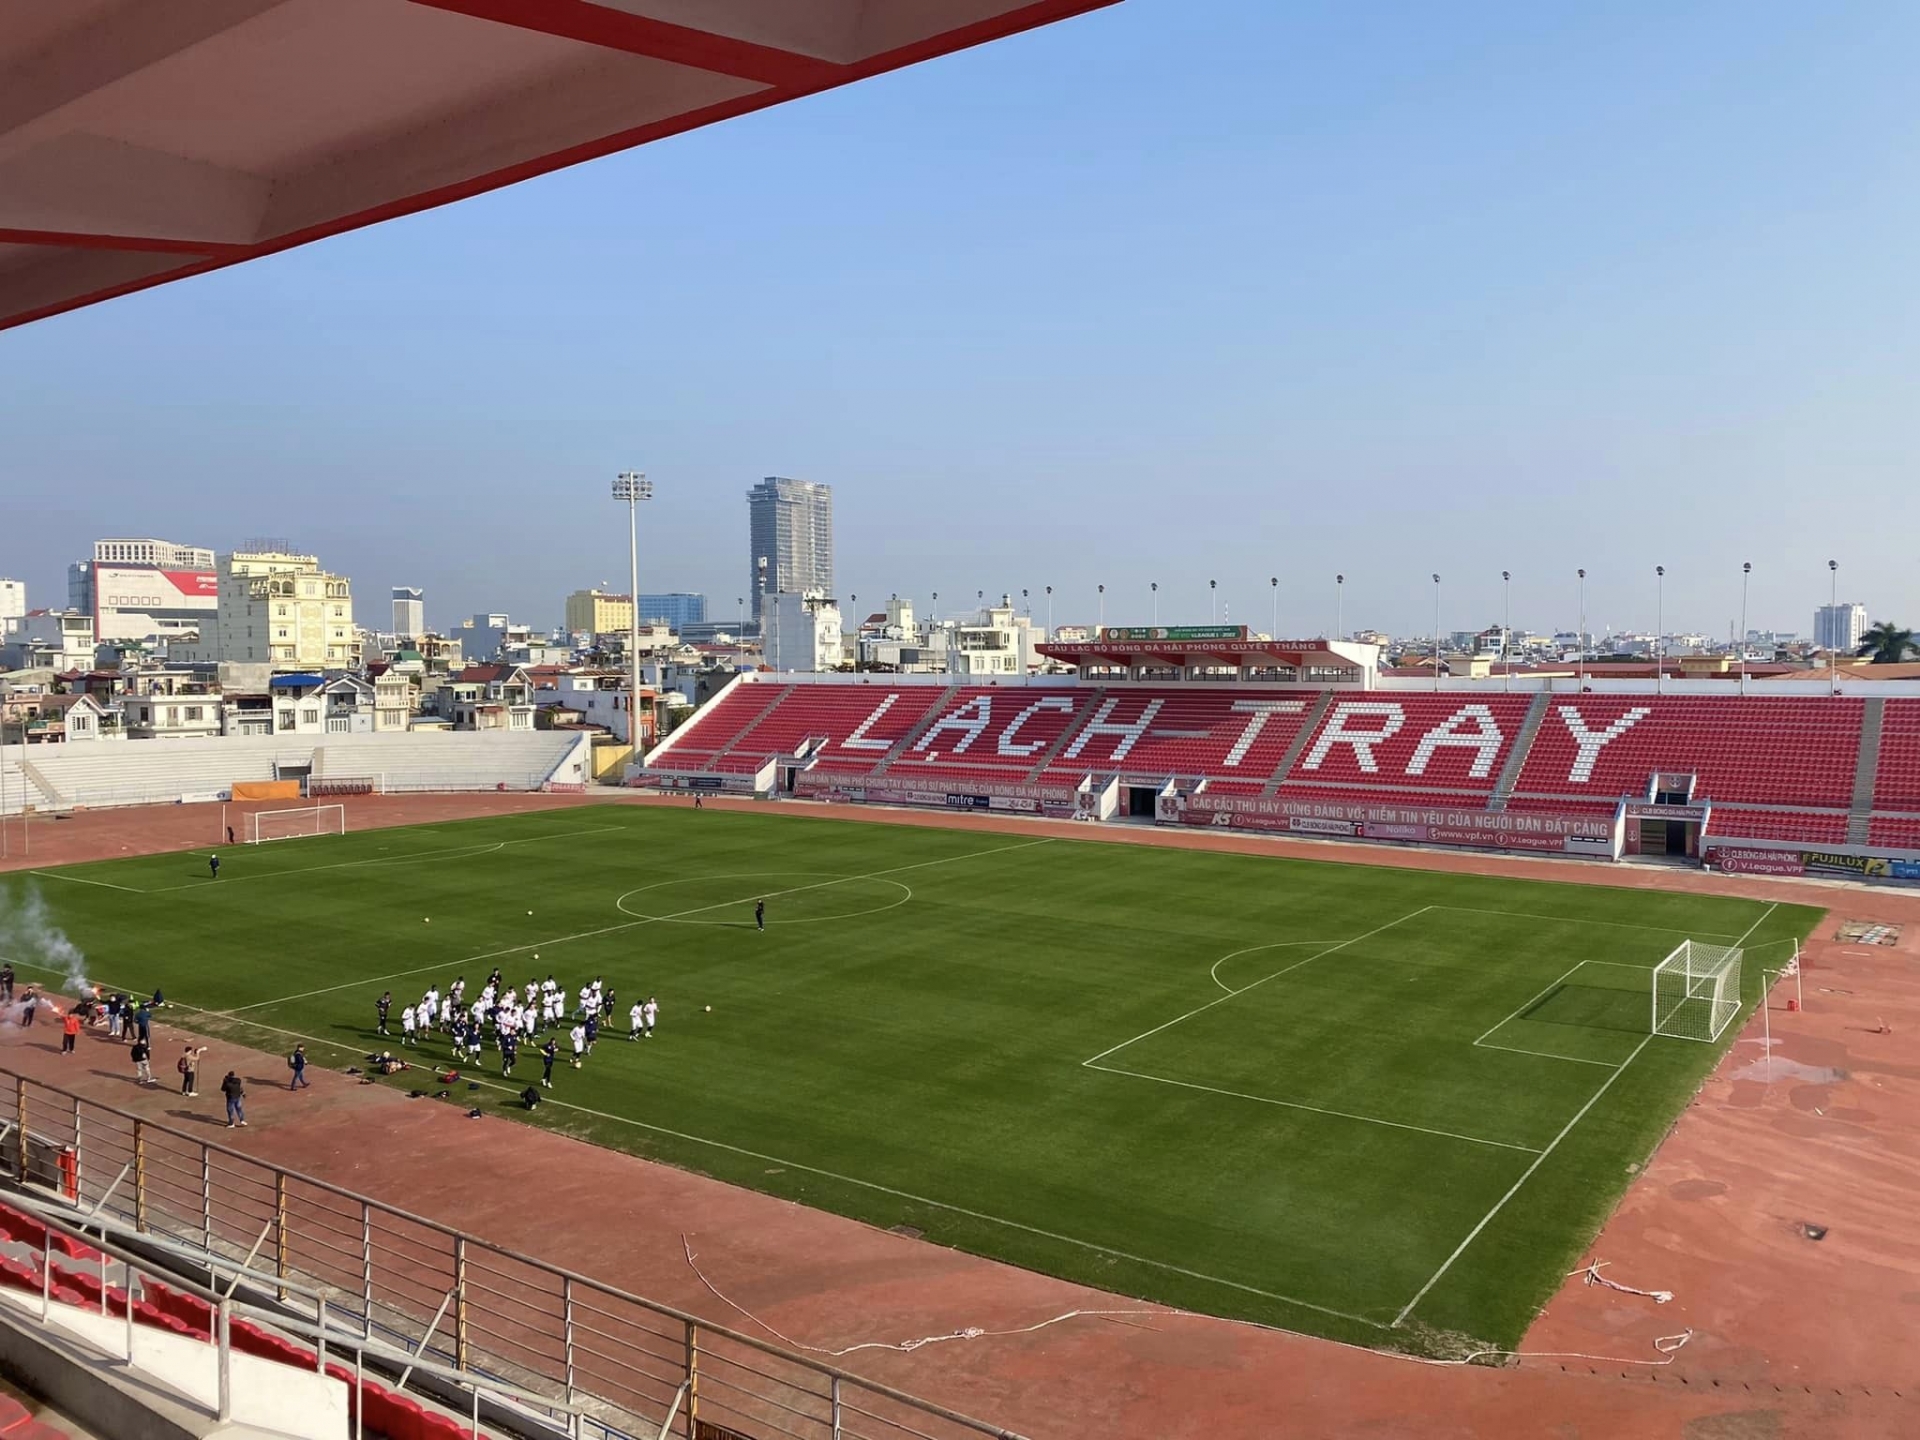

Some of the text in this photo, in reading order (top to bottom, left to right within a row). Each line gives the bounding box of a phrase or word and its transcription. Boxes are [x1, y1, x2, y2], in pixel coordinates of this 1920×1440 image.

[948, 795, 974, 805] mitre
[1193, 795, 1211, 809] CÁC
[1237, 797, 1256, 812] THỦ
[1315, 804, 1344, 818] ĐÁNG
[1400, 810, 1418, 823] TIN
[1422, 808, 1444, 825] YÊU
[1448, 810, 1471, 827] CỦA
[1475, 813, 1512, 830] NGƯỜI
[1516, 816, 1541, 832] DÂN
[1546, 817, 1570, 834] ĐẤT
[1574, 819, 1608, 836] CẢNG
[1812, 853, 1864, 867] FUJILUX
[1741, 862, 1804, 873] V.League.VPF
